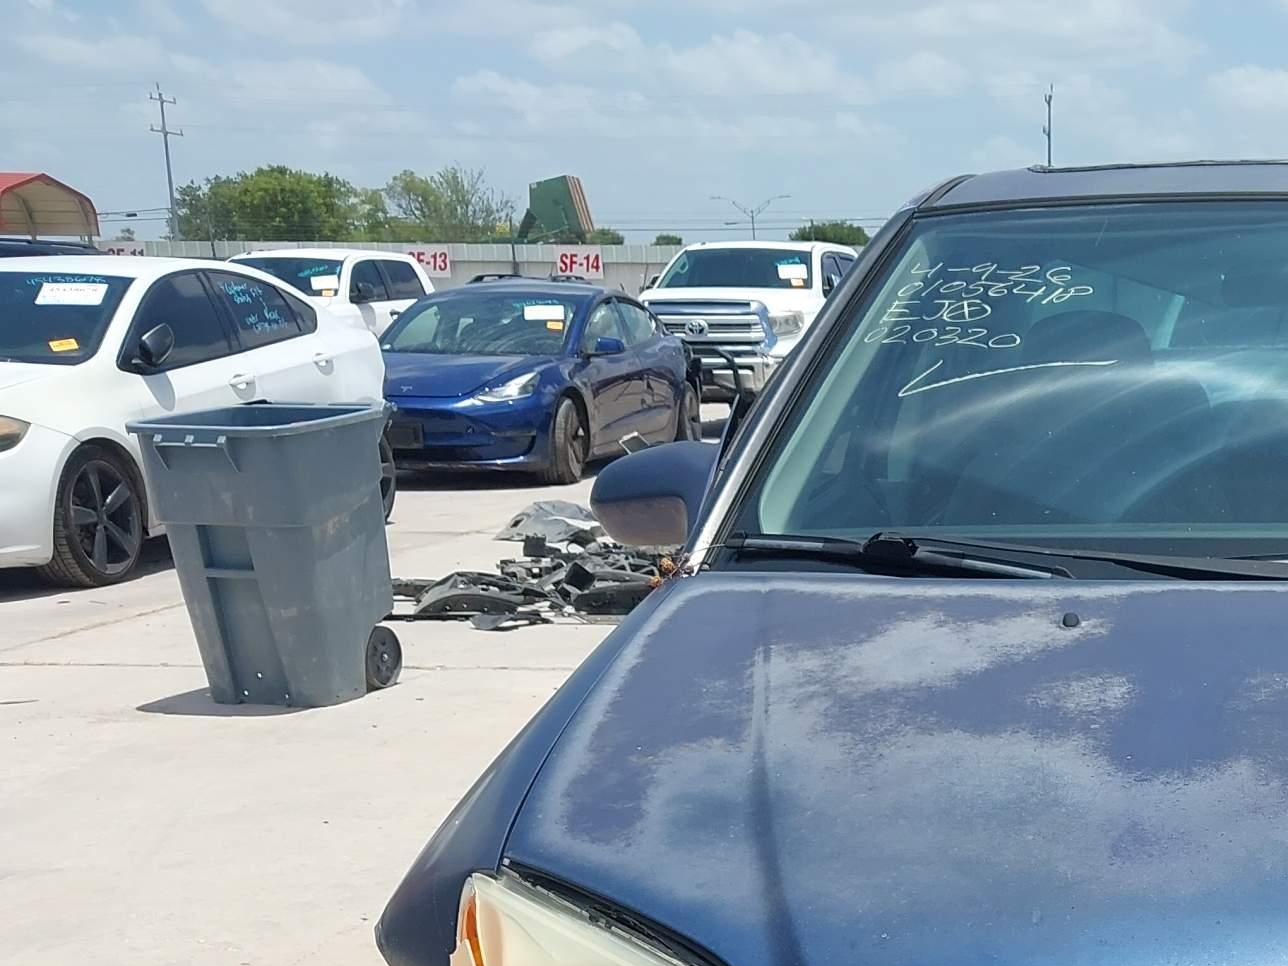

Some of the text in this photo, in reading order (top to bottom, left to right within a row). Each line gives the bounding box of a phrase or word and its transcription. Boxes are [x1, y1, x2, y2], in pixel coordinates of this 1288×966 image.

[559, 253, 600, 273] SF-14
[911, 262, 1072, 285] 4-9-26
[863, 325, 1021, 349] 020320
